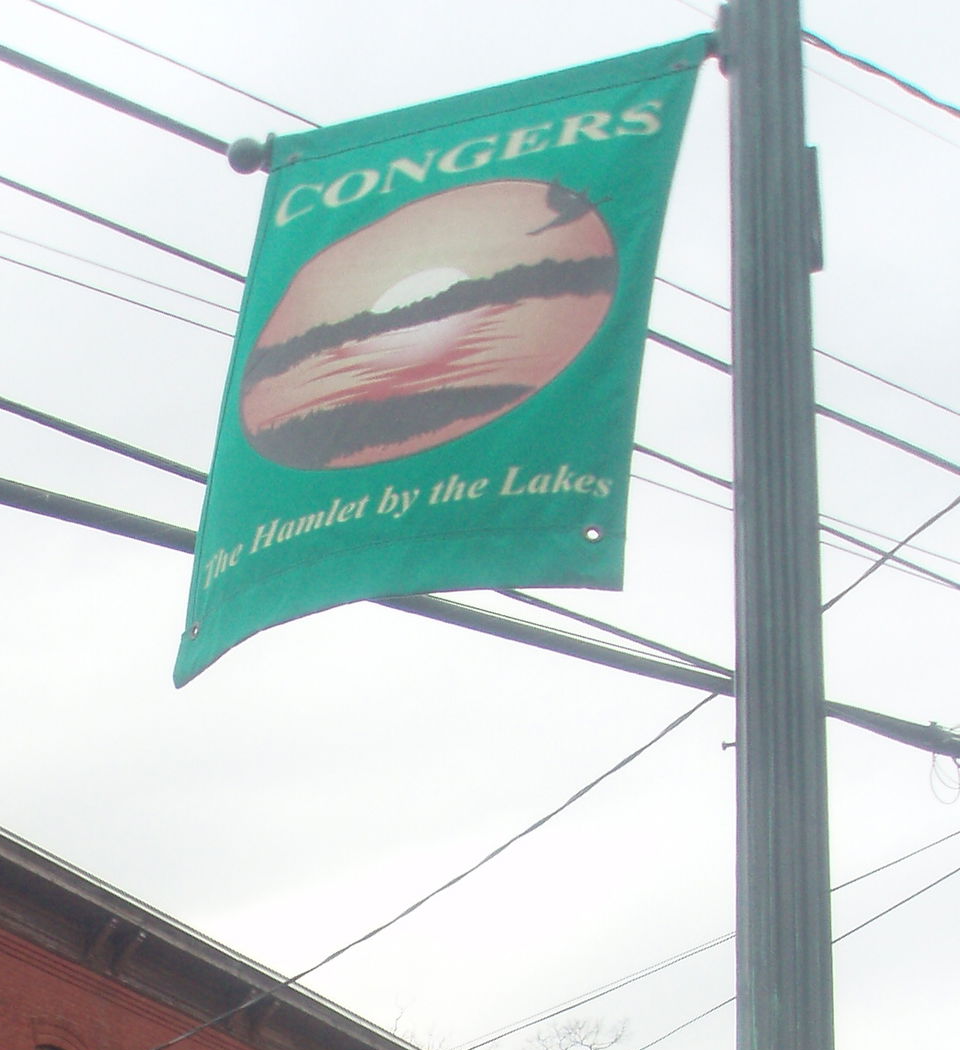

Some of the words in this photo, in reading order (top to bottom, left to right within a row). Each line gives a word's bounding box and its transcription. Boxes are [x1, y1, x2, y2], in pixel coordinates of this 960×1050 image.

[275, 101, 663, 227] CONGERS
[204, 544, 243, 588] The
[250, 496, 369, 553] Hamlet
[377, 486, 420, 518] by
[429, 474, 489, 505] the
[499, 464, 612, 498] Lakes
